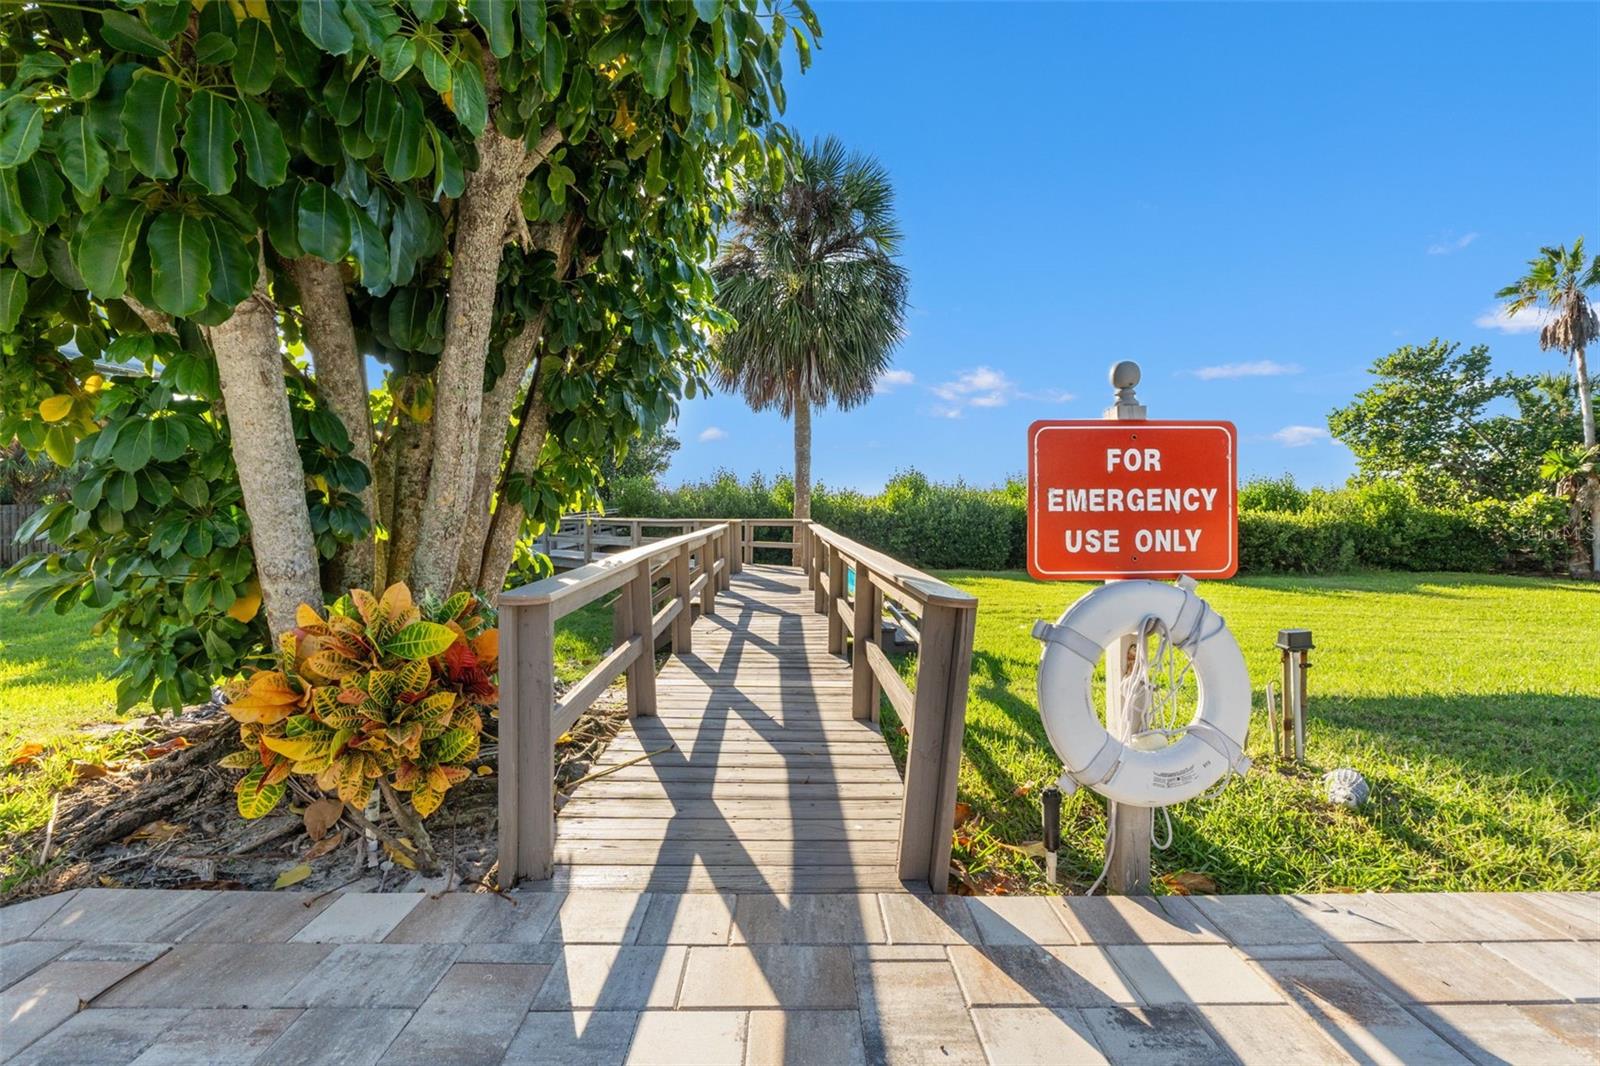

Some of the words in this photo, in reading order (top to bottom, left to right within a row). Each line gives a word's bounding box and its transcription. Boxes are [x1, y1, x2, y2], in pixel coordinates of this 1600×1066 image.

[1106, 448, 1161, 472] FOR
[1048, 488, 1217, 513] EMERGENCY
[1065, 529, 1120, 553] USE
[1135, 529, 1202, 552] ONLY
